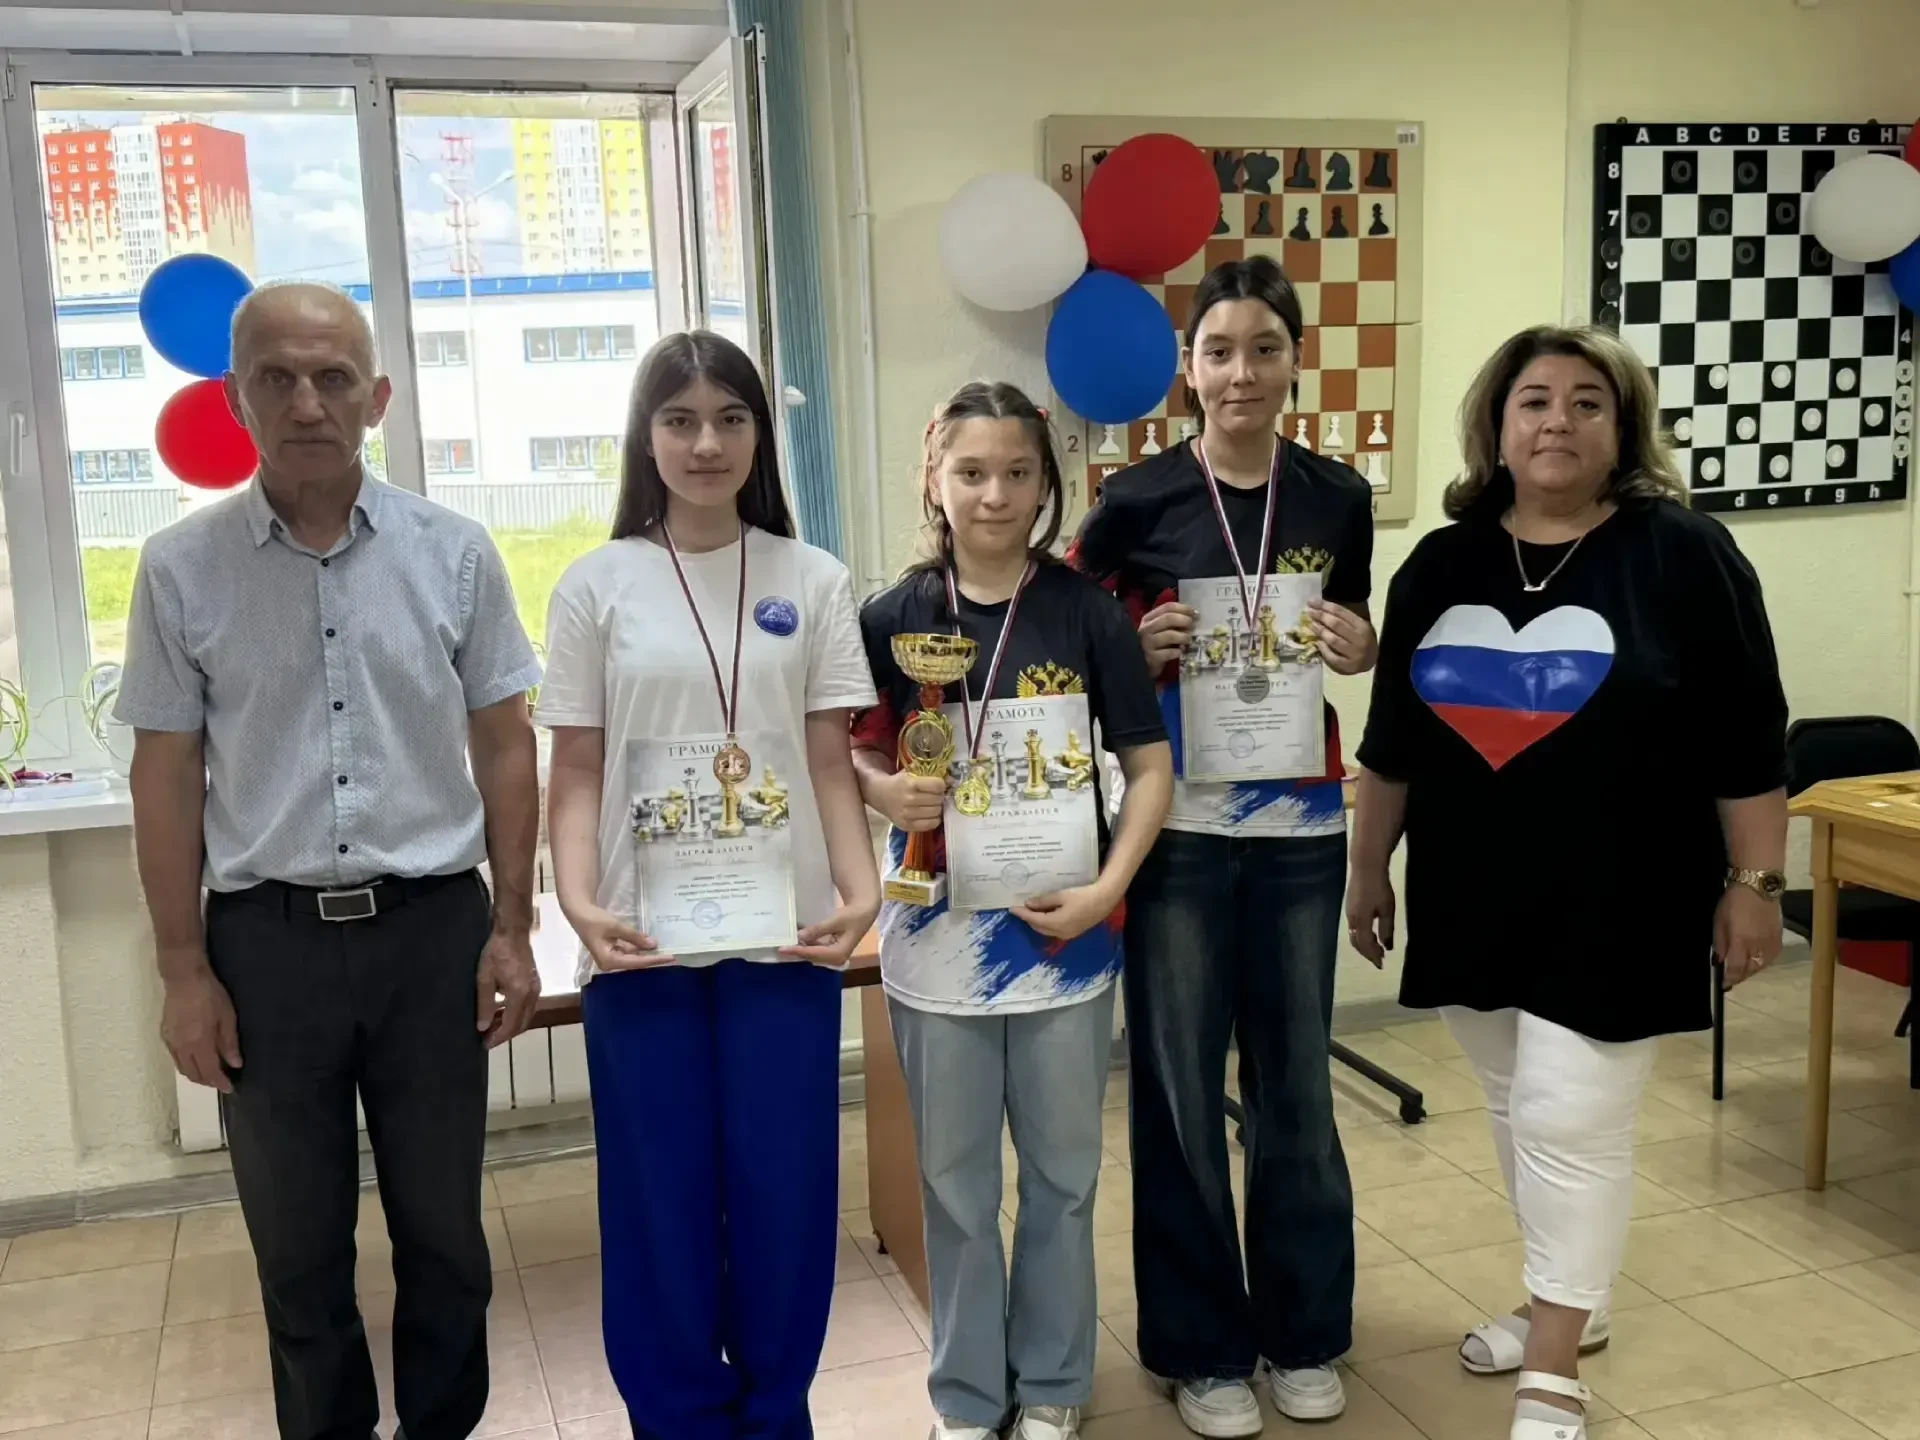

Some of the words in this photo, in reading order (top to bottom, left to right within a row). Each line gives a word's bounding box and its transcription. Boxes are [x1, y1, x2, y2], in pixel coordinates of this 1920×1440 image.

[1636, 127, 1650, 143] A
[1676, 127, 1689, 143] B
[1709, 127, 1722, 143] C
[1747, 127, 1760, 143] D
[1778, 126, 1790, 142] E
[1816, 127, 1827, 143] F
[1848, 127, 1860, 143] G
[1880, 127, 1893, 143] H
[1061, 163, 1073, 182] 8
[1607, 162, 1620, 179] 8
[1607, 209, 1620, 226] 7
[1900, 328, 1912, 343] 4
[1067, 435, 1079, 454] 2
[1069, 480, 1078, 498] 1
[1734, 492, 1745, 507] d
[1767, 493, 1779, 505] e
[1804, 487, 1813, 503] f
[1835, 488, 1846, 503] g
[1869, 484, 1880, 498] h
[977, 707, 1045, 721] РАМОТА
